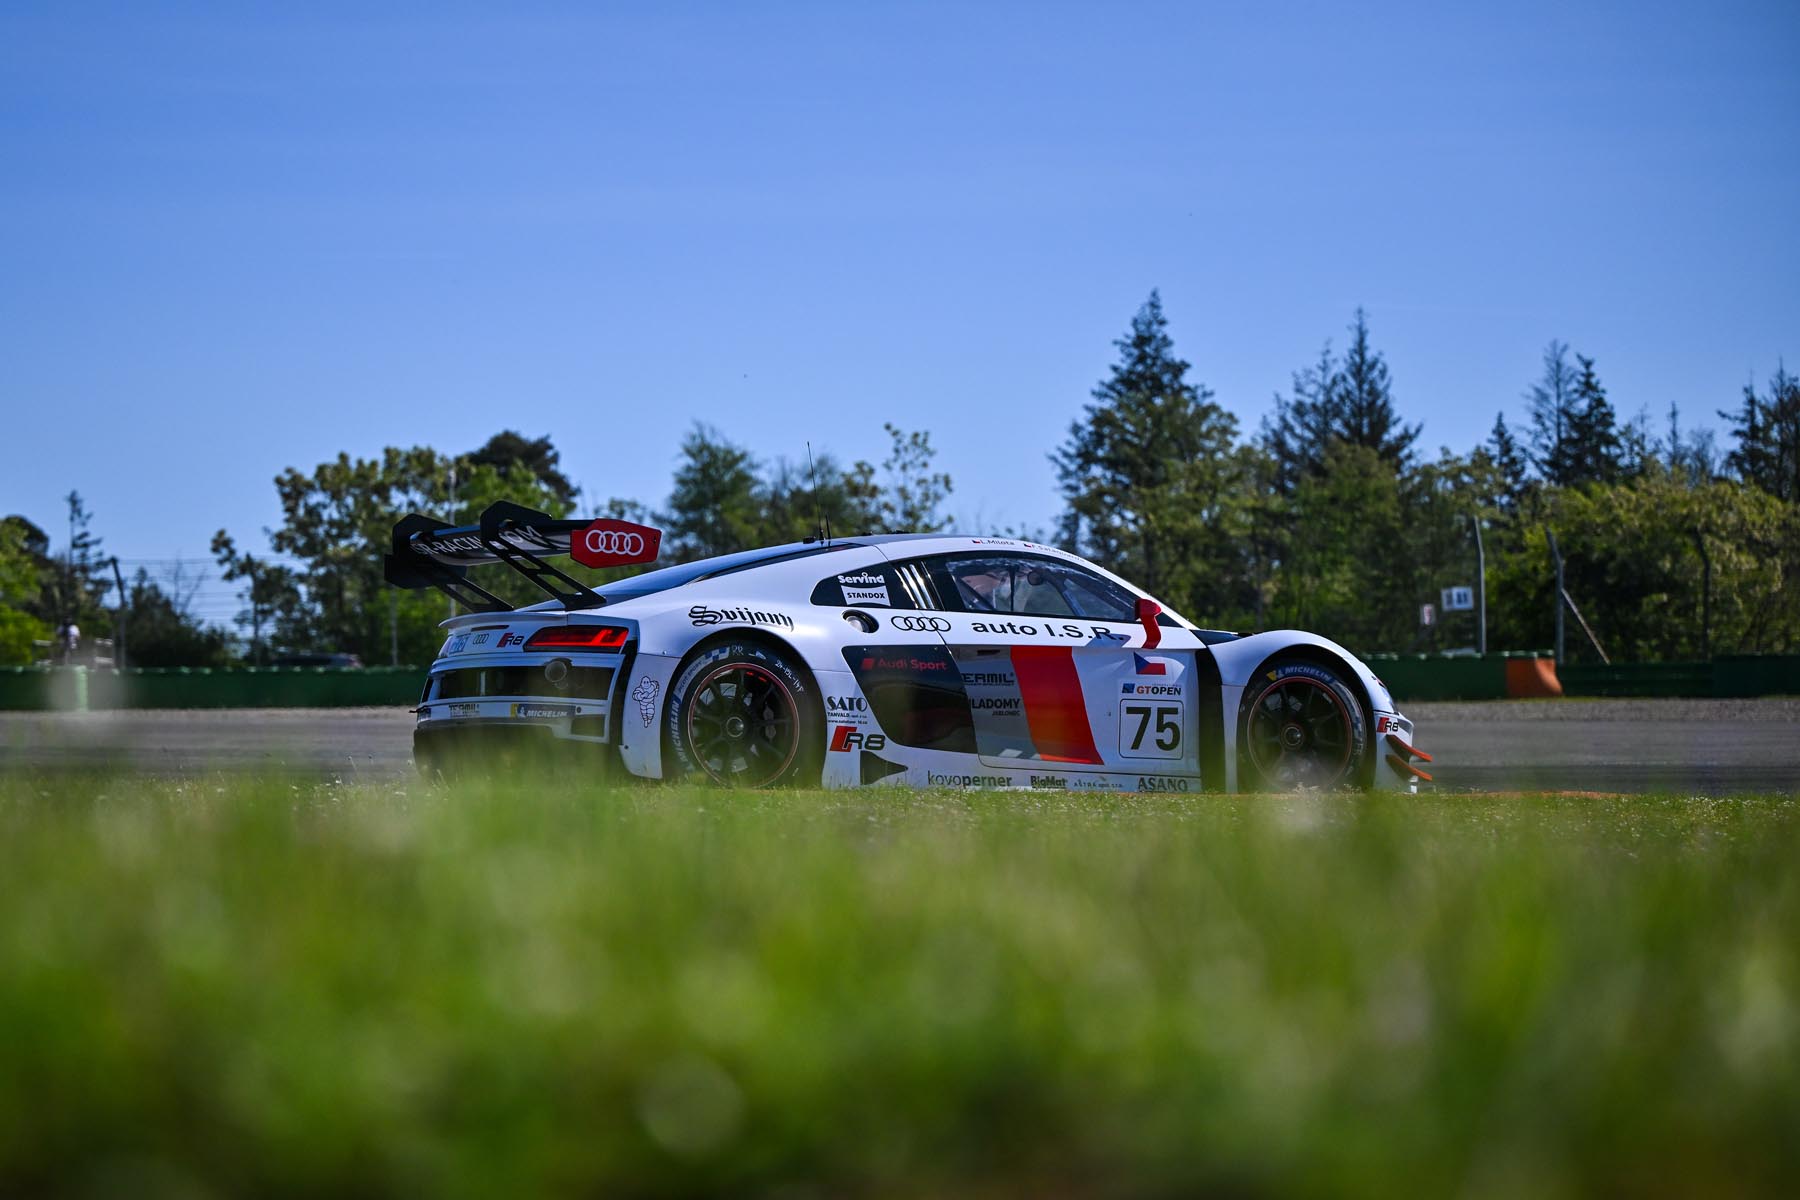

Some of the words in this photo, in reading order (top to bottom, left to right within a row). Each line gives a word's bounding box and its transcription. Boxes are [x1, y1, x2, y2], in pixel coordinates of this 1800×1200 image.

[837, 571, 886, 584] Servind
[688, 605, 794, 632] Svijany
[971, 621, 1038, 636] auto
[1043, 623, 1125, 641] I.S.R.
[502, 633, 525, 646] R8
[877, 659, 908, 669] Audi
[911, 660, 947, 671] Sport
[1285, 664, 1332, 682] MICHELIN
[1136, 685, 1182, 696] GTOPEN
[826, 695, 868, 712] SATO
[969, 698, 1020, 710] LADOMY
[526, 709, 568, 718] MICHELIN
[1125, 706, 1181, 751] 75
[1380, 718, 1399, 733] R8
[927, 770, 1013, 790] kovoperner
[1138, 776, 1188, 792] ASANO
